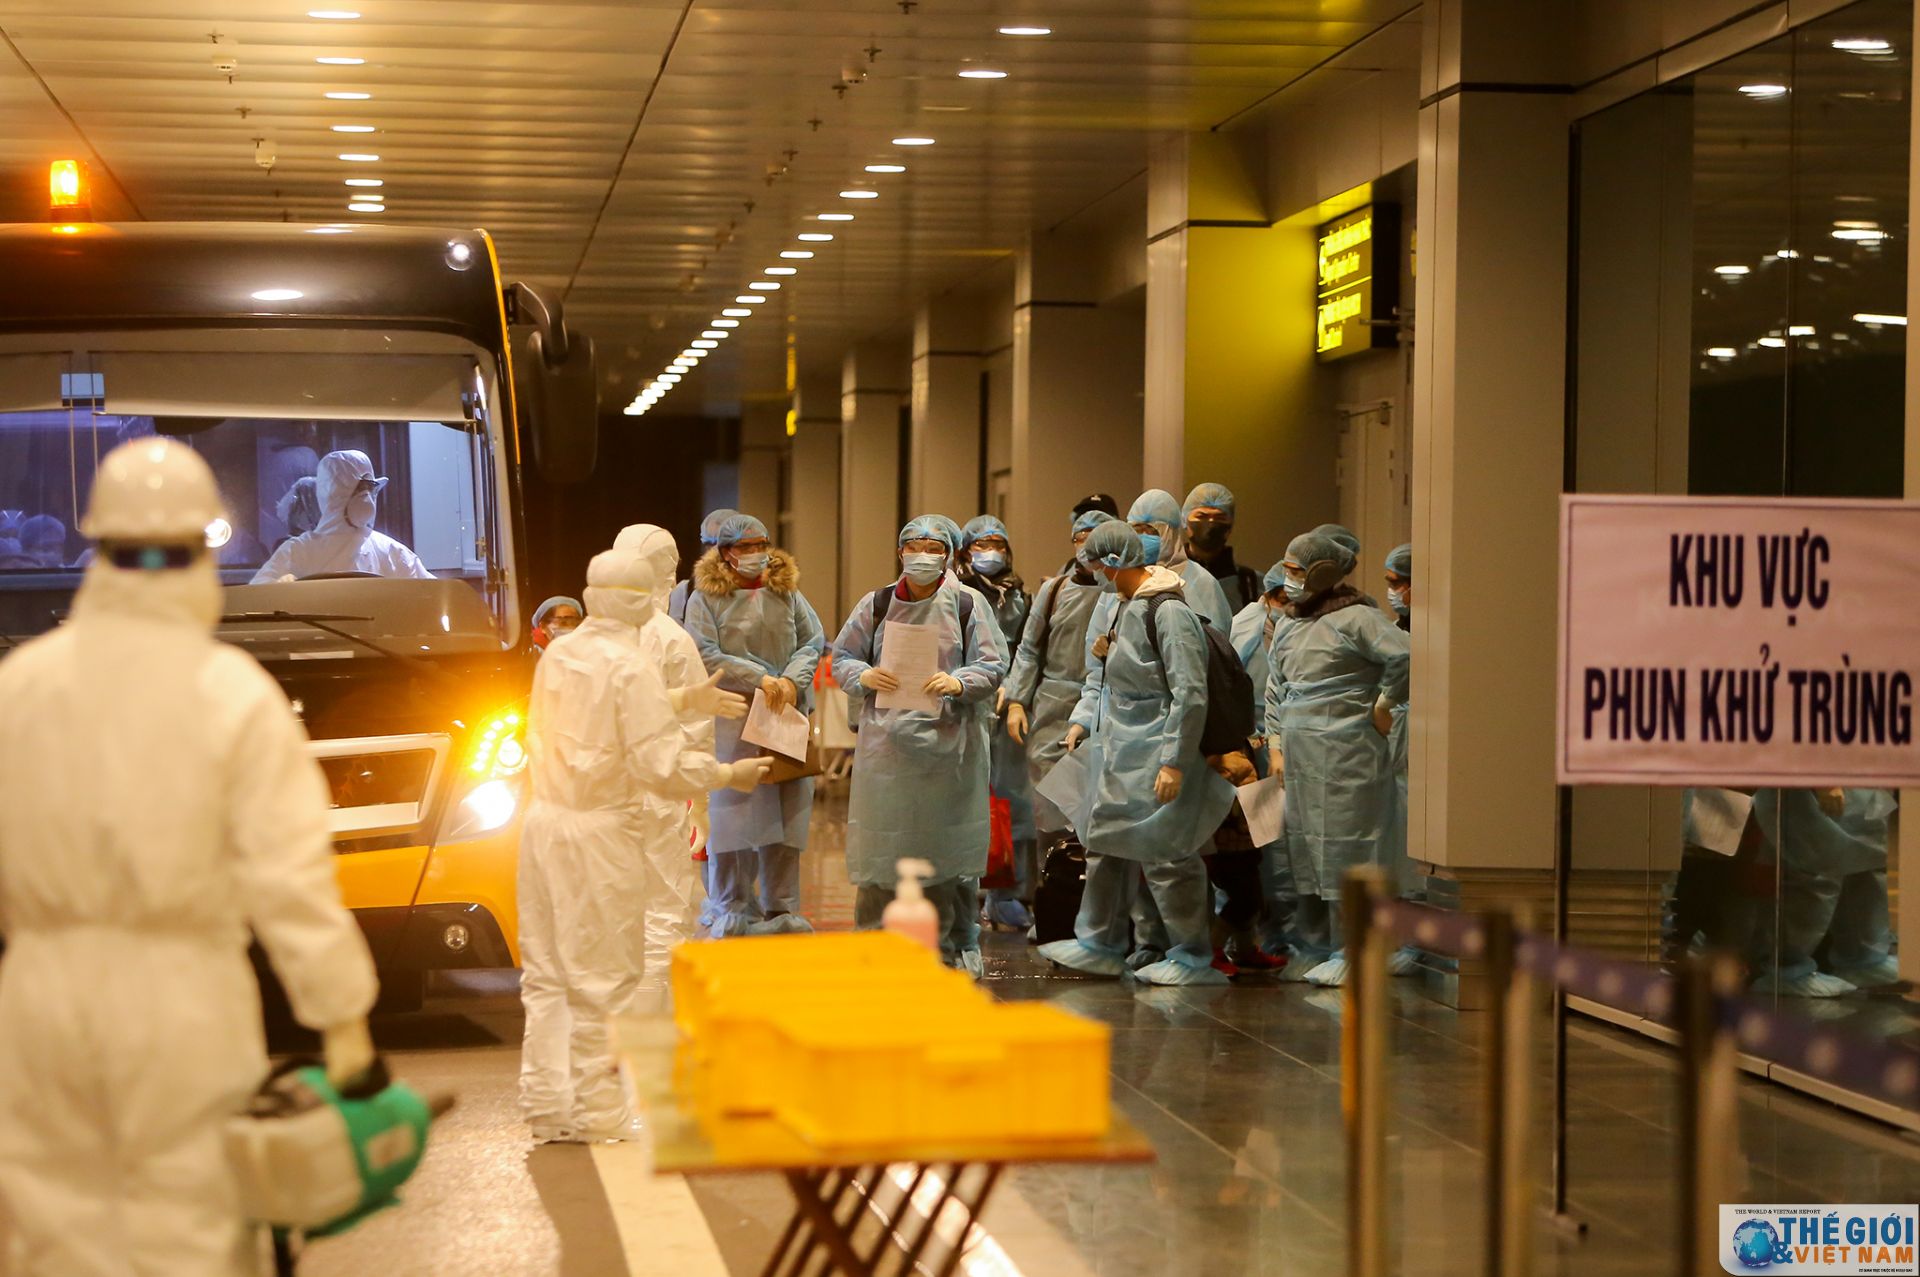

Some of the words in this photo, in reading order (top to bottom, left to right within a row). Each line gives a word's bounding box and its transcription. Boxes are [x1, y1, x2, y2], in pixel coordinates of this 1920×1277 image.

[1669, 533, 1745, 609] KHU
[1757, 526, 1830, 627] VỰC
[1583, 667, 1686, 742] PHUN
[1700, 642, 1780, 744] KHỬ
[1788, 653, 1912, 746] TRÙNG
